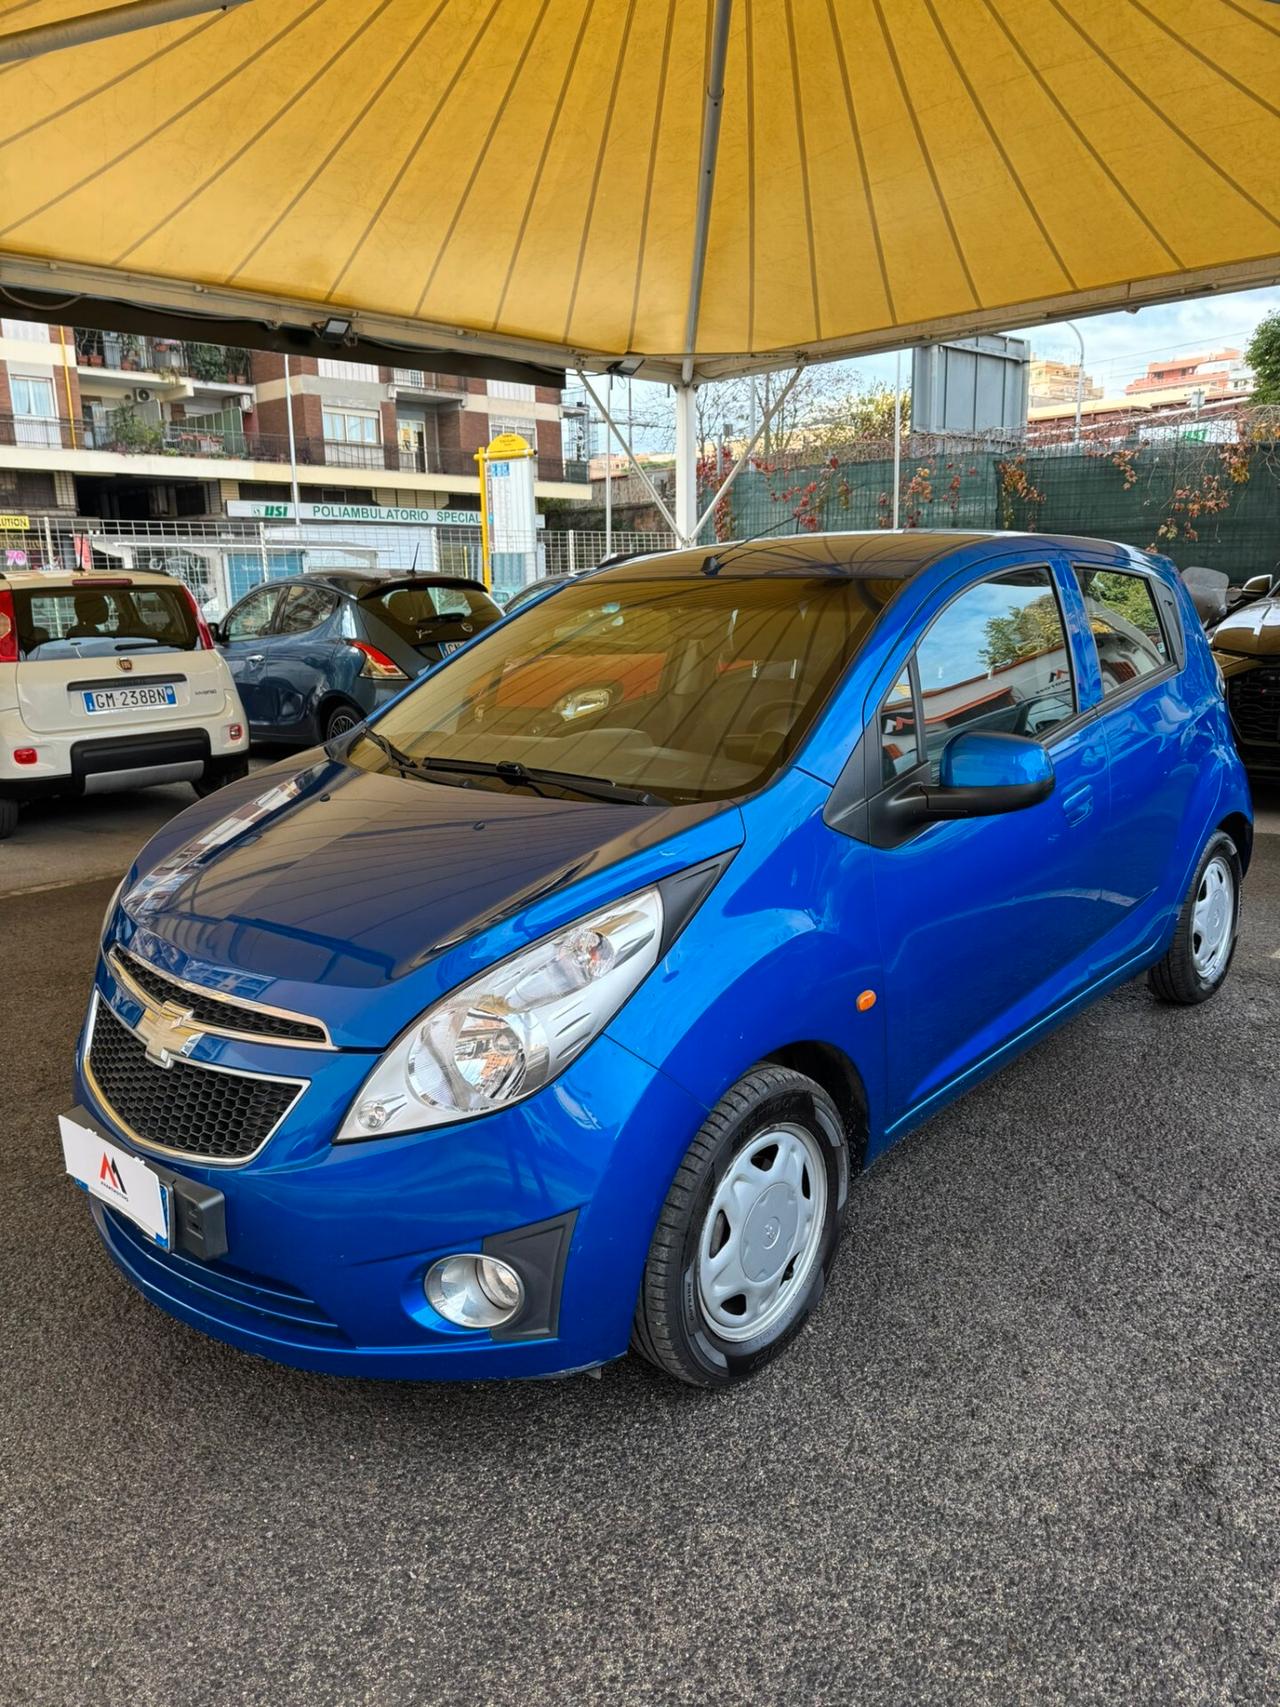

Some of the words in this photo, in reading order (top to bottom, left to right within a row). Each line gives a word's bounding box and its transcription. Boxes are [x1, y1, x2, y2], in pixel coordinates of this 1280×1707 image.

[313, 505, 429, 521] POLIAMBULATORIO
[95, 693, 116, 709] GM
[120, 688, 167, 706] 238BN
